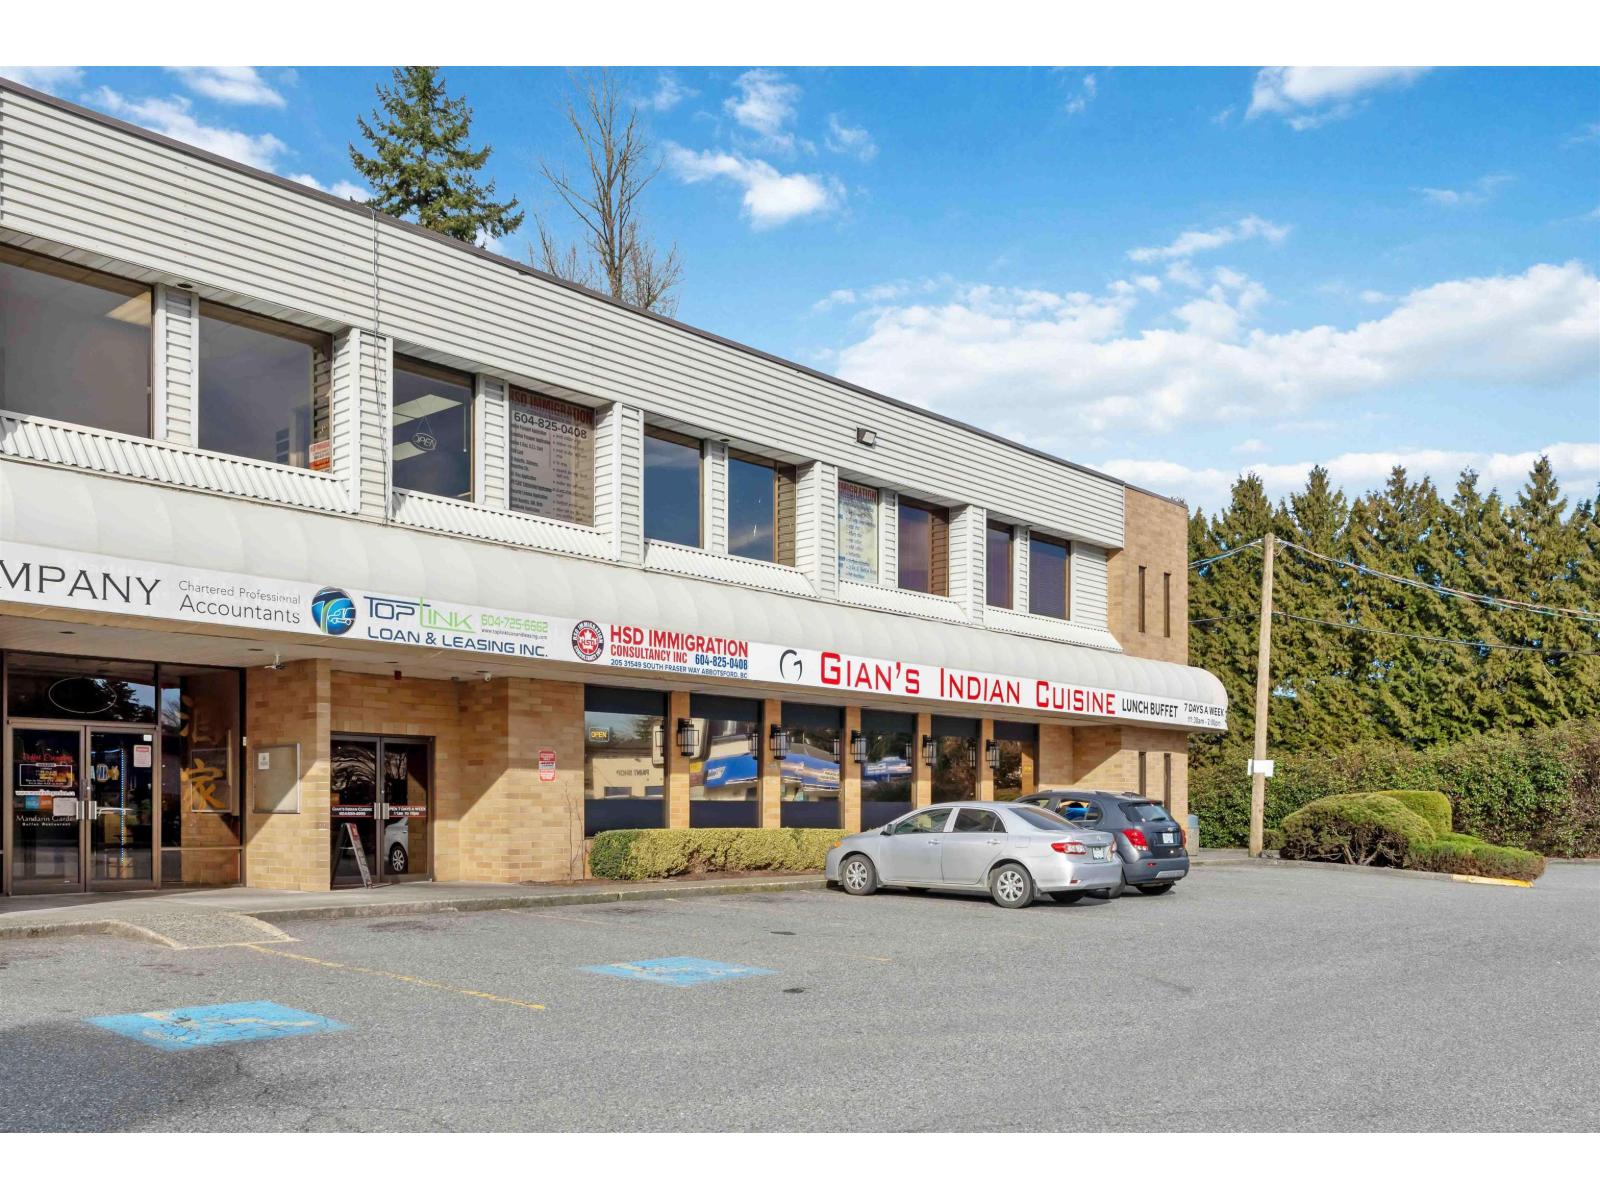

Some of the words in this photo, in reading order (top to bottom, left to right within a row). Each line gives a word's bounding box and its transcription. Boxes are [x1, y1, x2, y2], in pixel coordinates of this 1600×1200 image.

[514, 412, 587, 439] 604-825-0408
[0, 560, 161, 605] MPANY
[178, 580, 235, 597] Chartered
[180, 594, 300, 623] Accountants
[368, 626, 420, 643] LOAN
[426, 632, 436, 645] &
[443, 635, 516, 653] LEASING
[520, 643, 548, 657] INC.
[610, 624, 645, 646] HSD
[648, 630, 749, 658] IMMIGRATION
[610, 644, 671, 662] CONSULTANCY
[673, 652, 688, 664] INC
[694, 653, 748, 670] 604-825-0408
[643, 662, 664, 670] SOUTH
[665, 665, 687, 673] FRASER
[688, 666, 701, 674] WAY
[820, 651, 920, 695] GIAN'S
[940, 667, 1020, 705] INDIAN
[1035, 680, 1116, 715] CUISINE
[1122, 698, 1149, 714] LUNCH
[1150, 700, 1178, 718] BUFFET
[1184, 703, 1188, 712] 7
[1188, 703, 1204, 714] DAYS
[1204, 706, 1209, 715] A
[1209, 706, 1225, 717] WEEK
[52, 814, 76, 822] Garde
